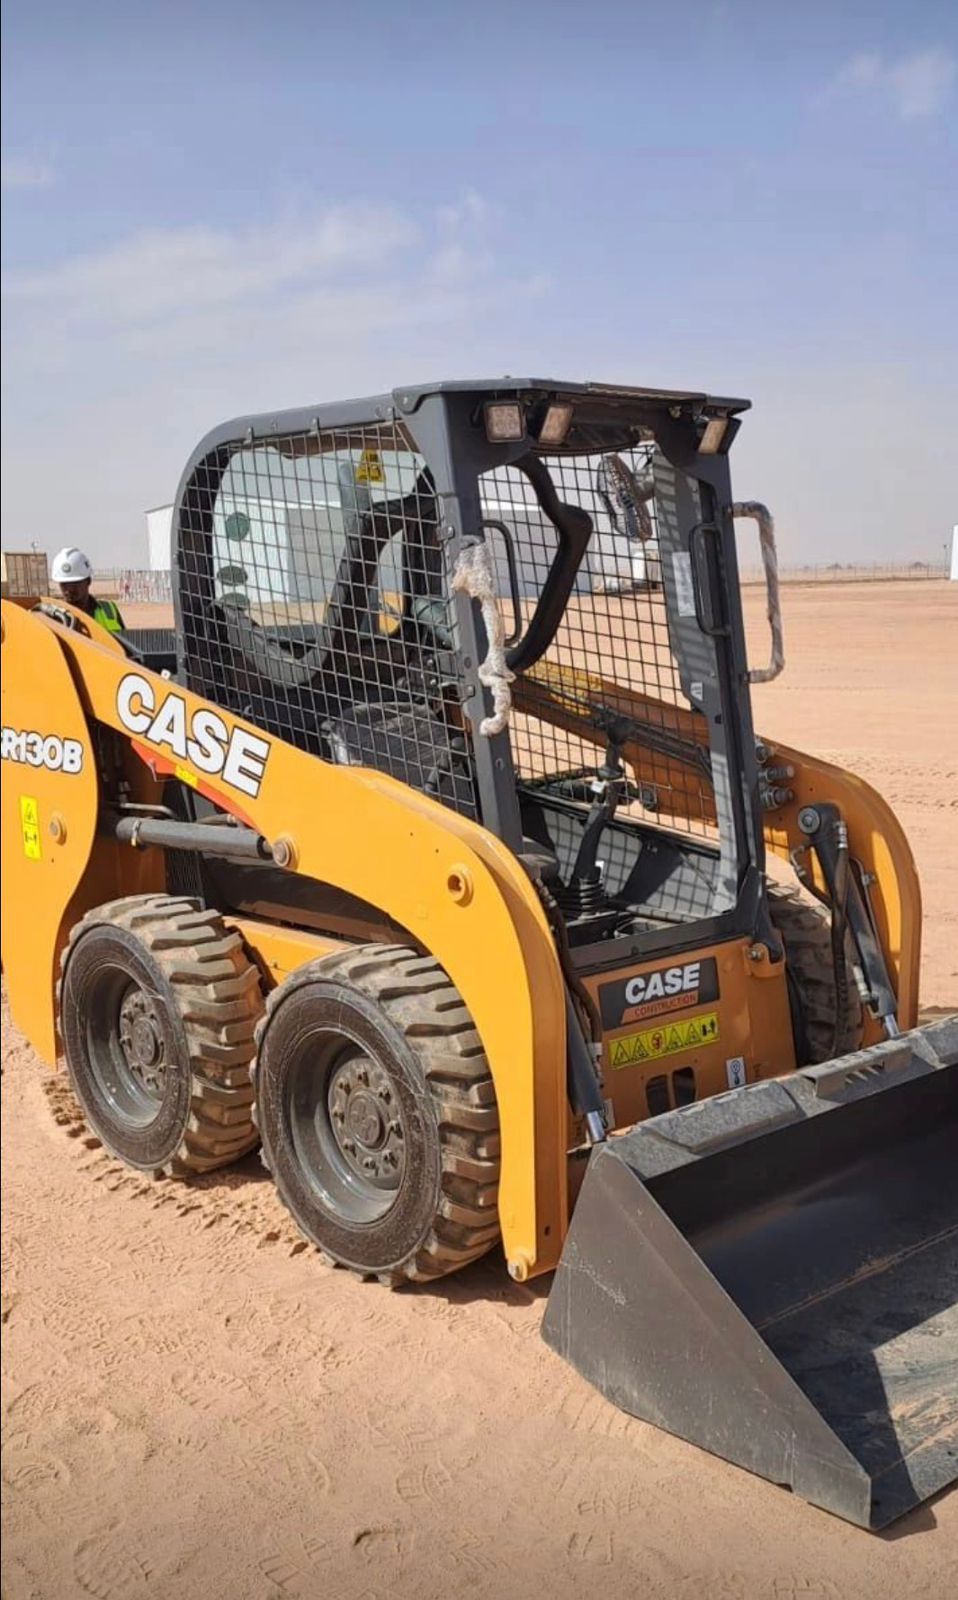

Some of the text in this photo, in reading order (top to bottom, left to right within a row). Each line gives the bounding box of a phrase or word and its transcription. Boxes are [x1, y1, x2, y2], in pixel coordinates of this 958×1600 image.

[1, 726, 83, 774] R130B
[116, 673, 271, 798] CASE
[625, 962, 700, 1004] CASE
